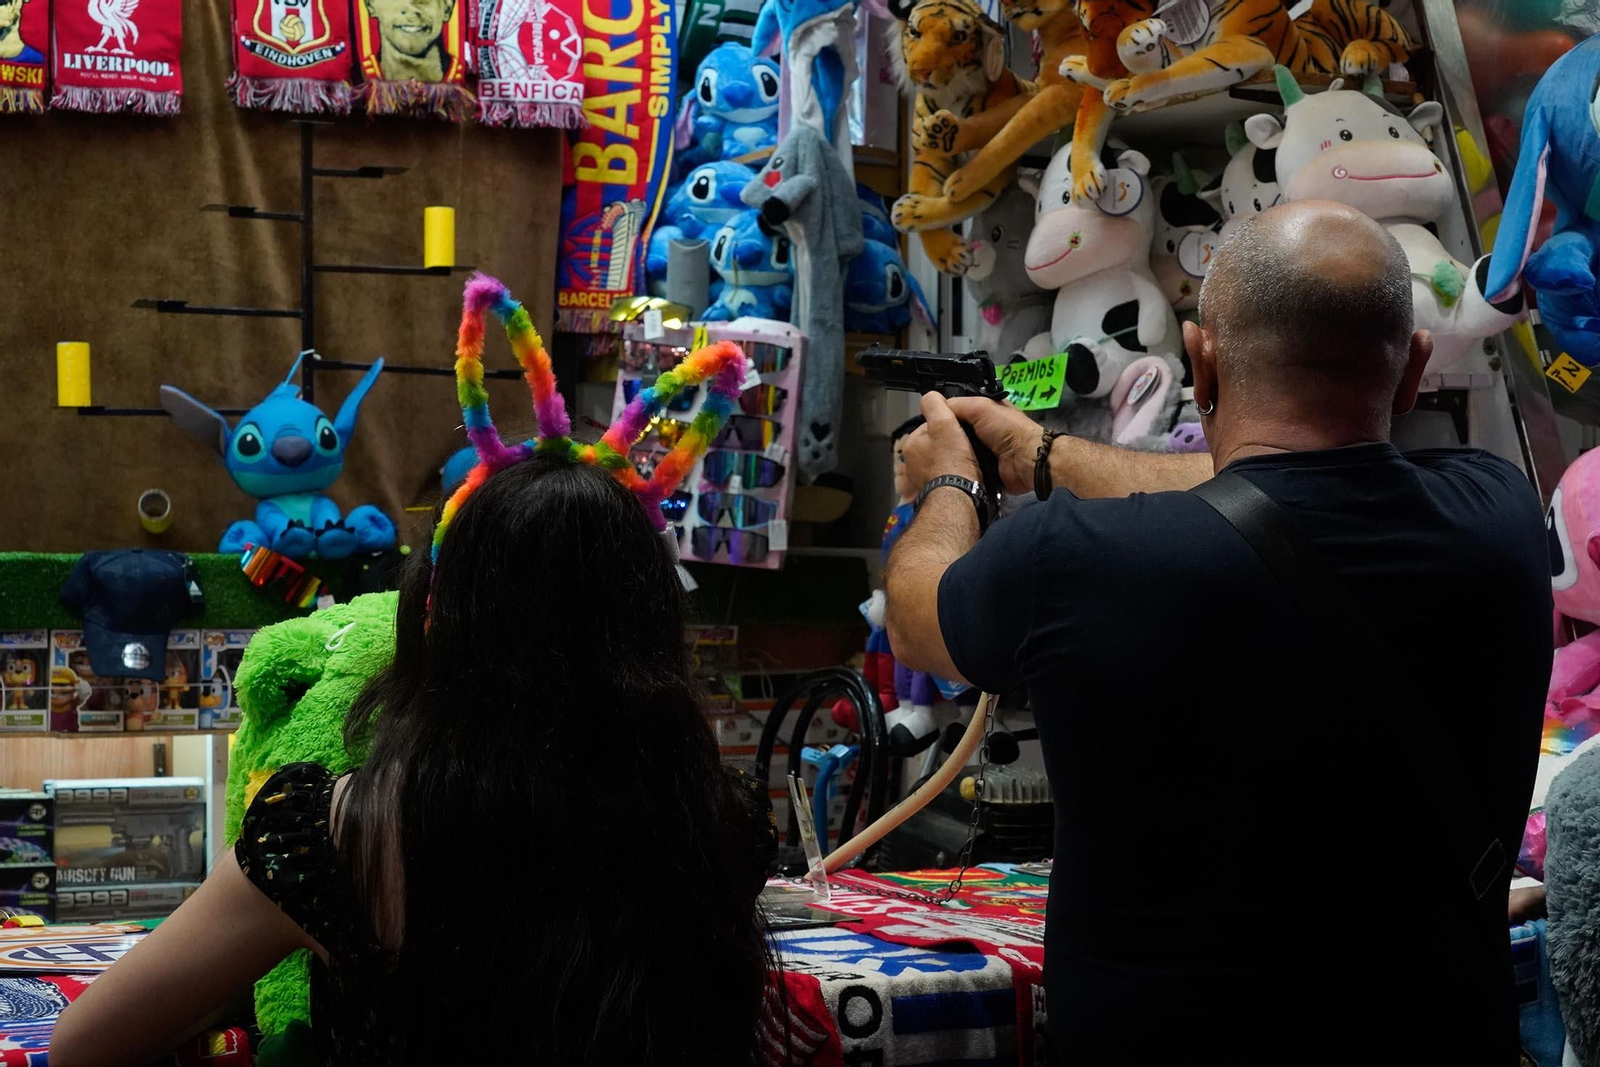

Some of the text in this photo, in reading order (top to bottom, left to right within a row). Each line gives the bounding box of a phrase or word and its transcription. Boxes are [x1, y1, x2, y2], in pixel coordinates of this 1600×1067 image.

[63, 53, 174, 77] LIVERPOOL
[254, 43, 334, 67] EINDHOVEN
[648, 0, 673, 118] SIMPLY
[0, 64, 43, 85] WSKI
[480, 81, 581, 102] BENFICA
[558, 291, 634, 308] BARCEL
[1001, 358, 1055, 386] PREMIOS
[109, 865, 136, 881] GUN
